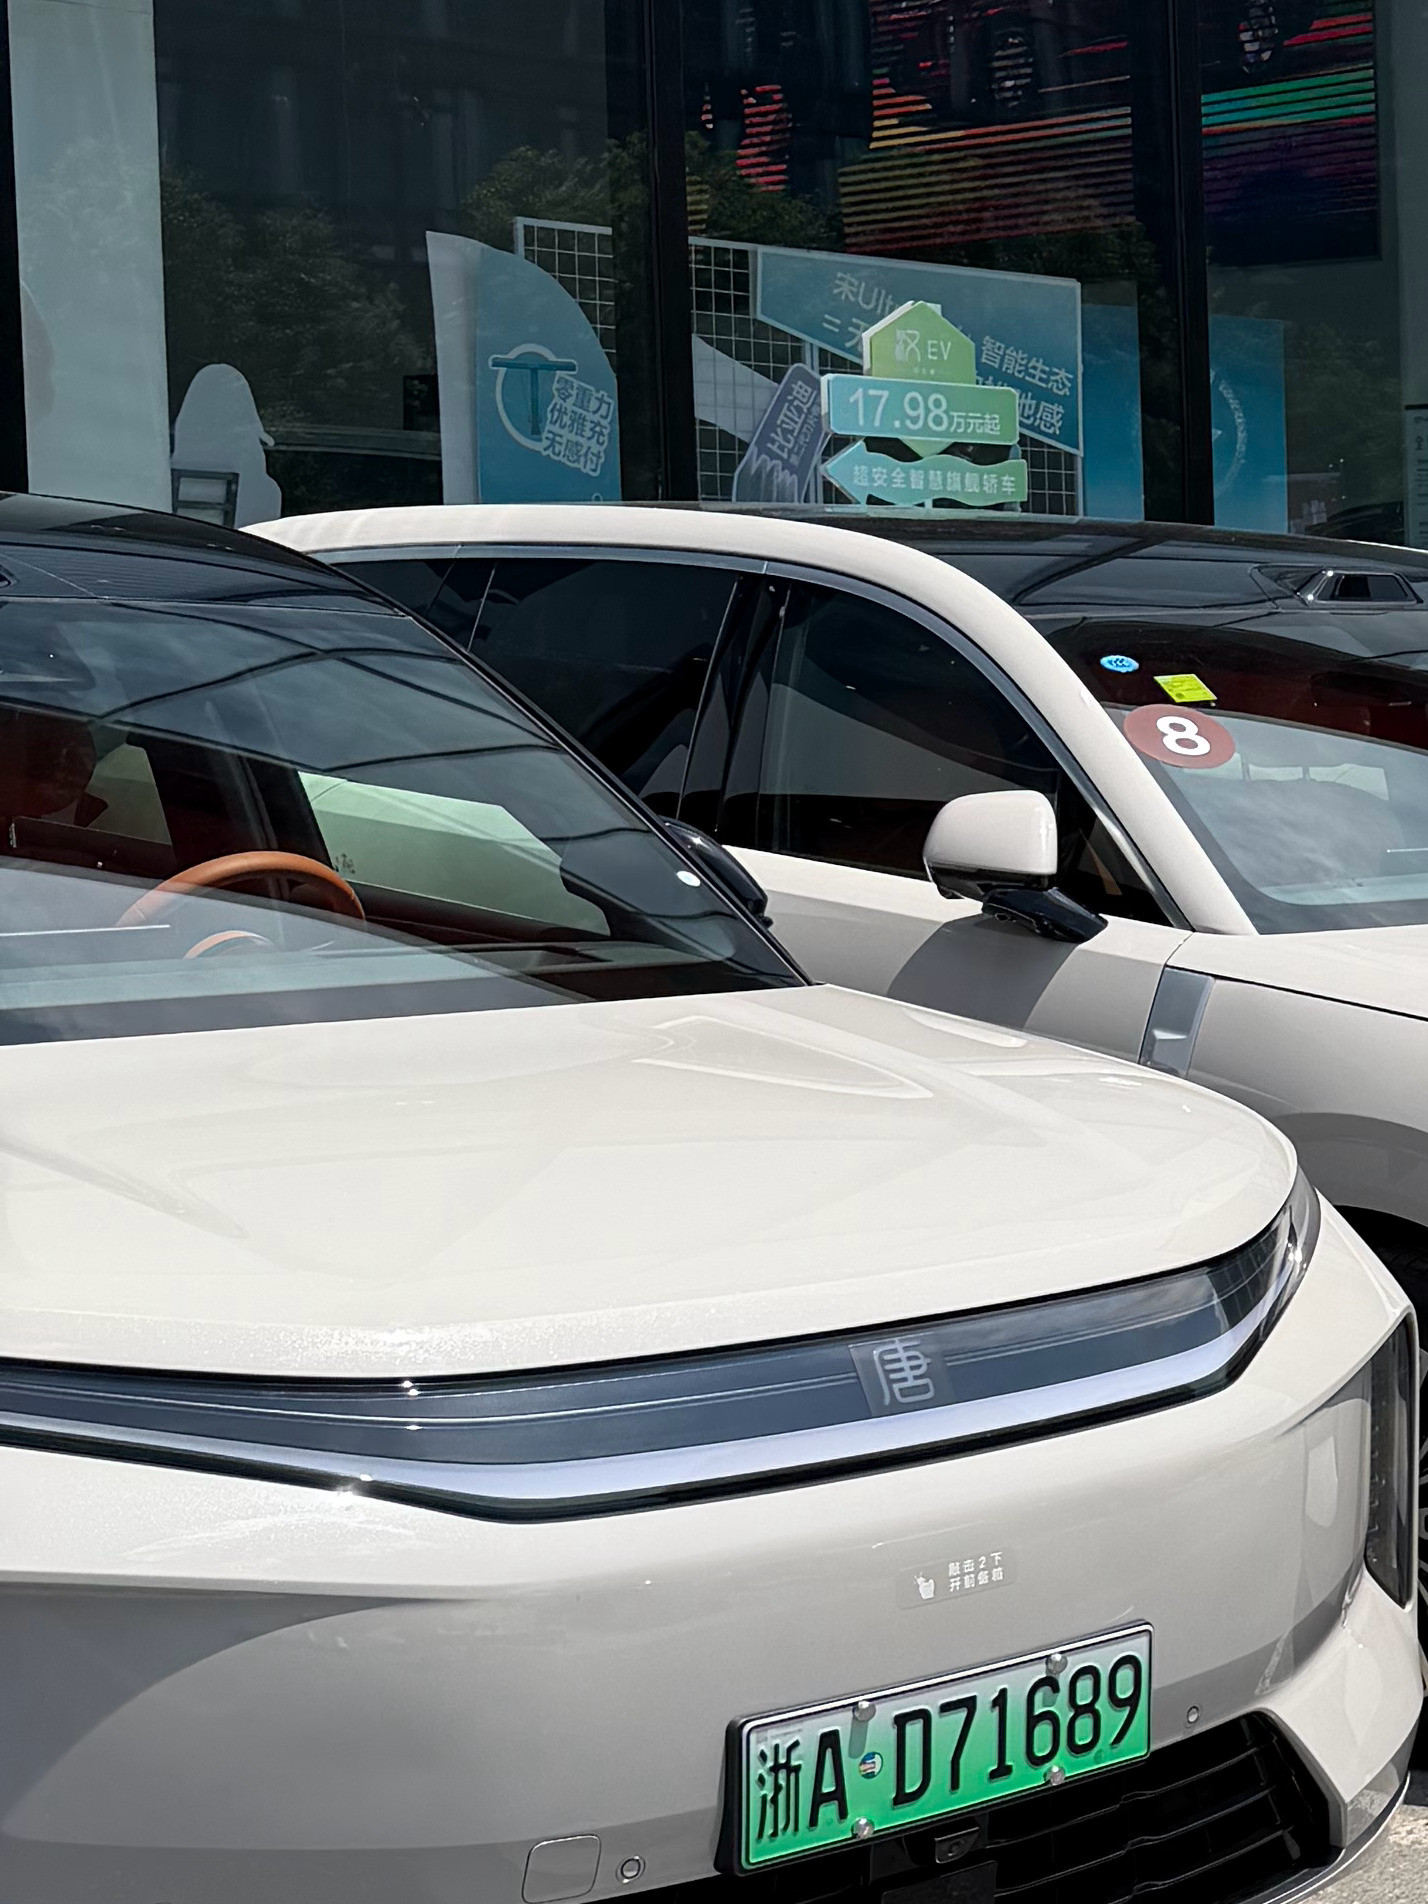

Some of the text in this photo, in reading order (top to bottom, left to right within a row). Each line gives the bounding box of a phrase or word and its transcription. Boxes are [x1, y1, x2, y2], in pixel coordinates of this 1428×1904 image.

[927, 339, 951, 361] EV
[981, 336, 1073, 396] 智能生态
[554, 376, 614, 421] 零重力
[766, 381, 818, 459] 比亚迪
[849, 388, 1001, 435] 17.98万元起
[549, 402, 609, 447] 优雅充
[544, 430, 603, 474] 无感付
[1155, 715, 1212, 757] 8
